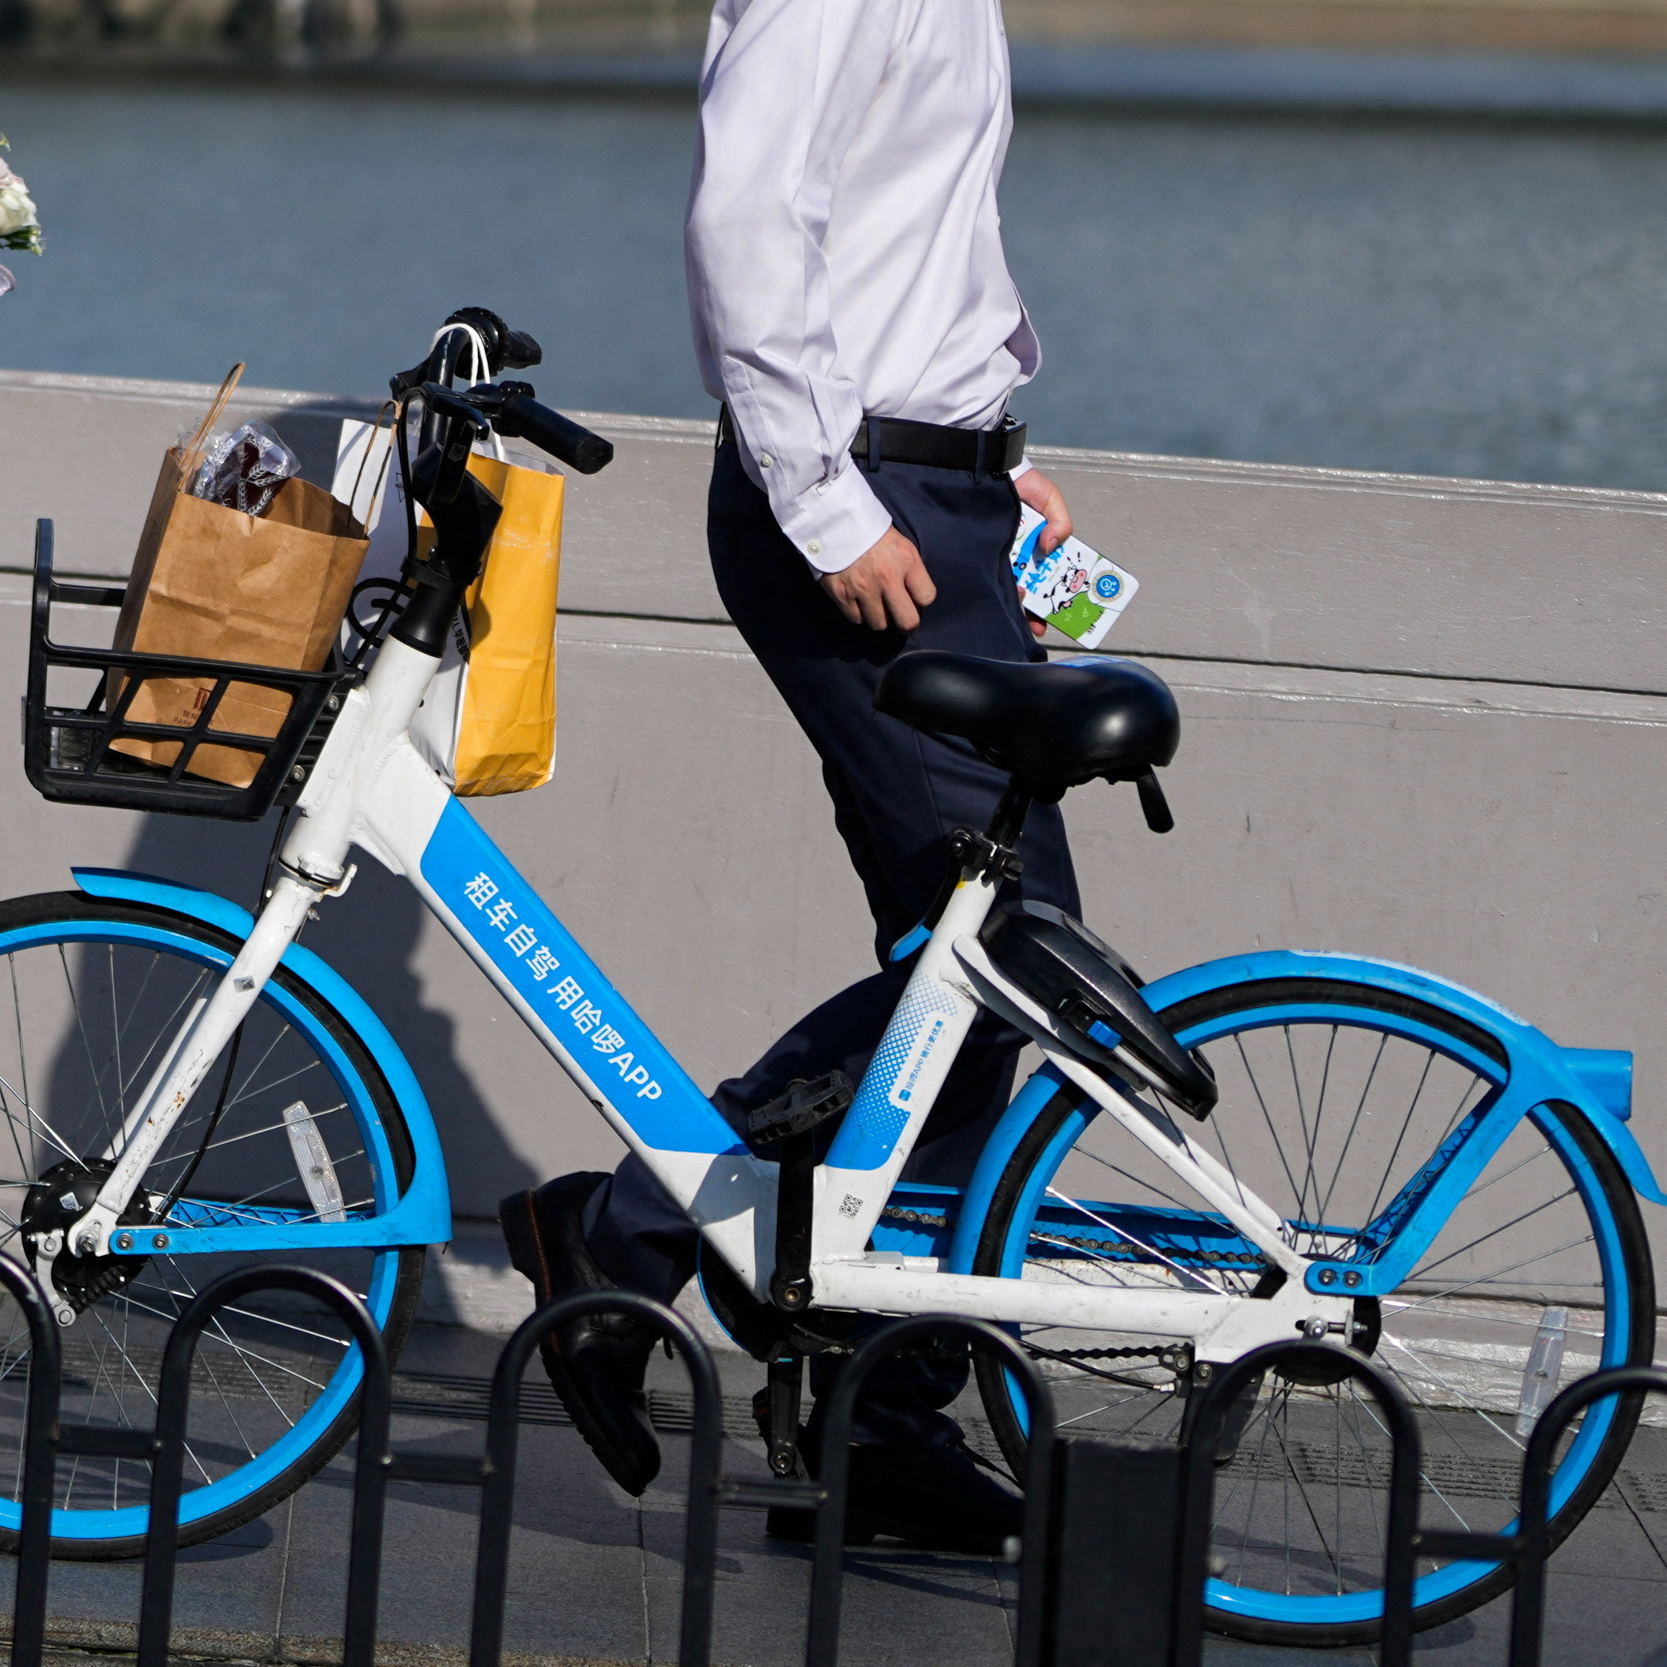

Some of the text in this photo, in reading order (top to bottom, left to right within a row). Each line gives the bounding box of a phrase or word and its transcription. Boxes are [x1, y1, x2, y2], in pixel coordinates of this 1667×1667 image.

[463, 870, 662, 1102] 租车自驾 用哈啰APP
